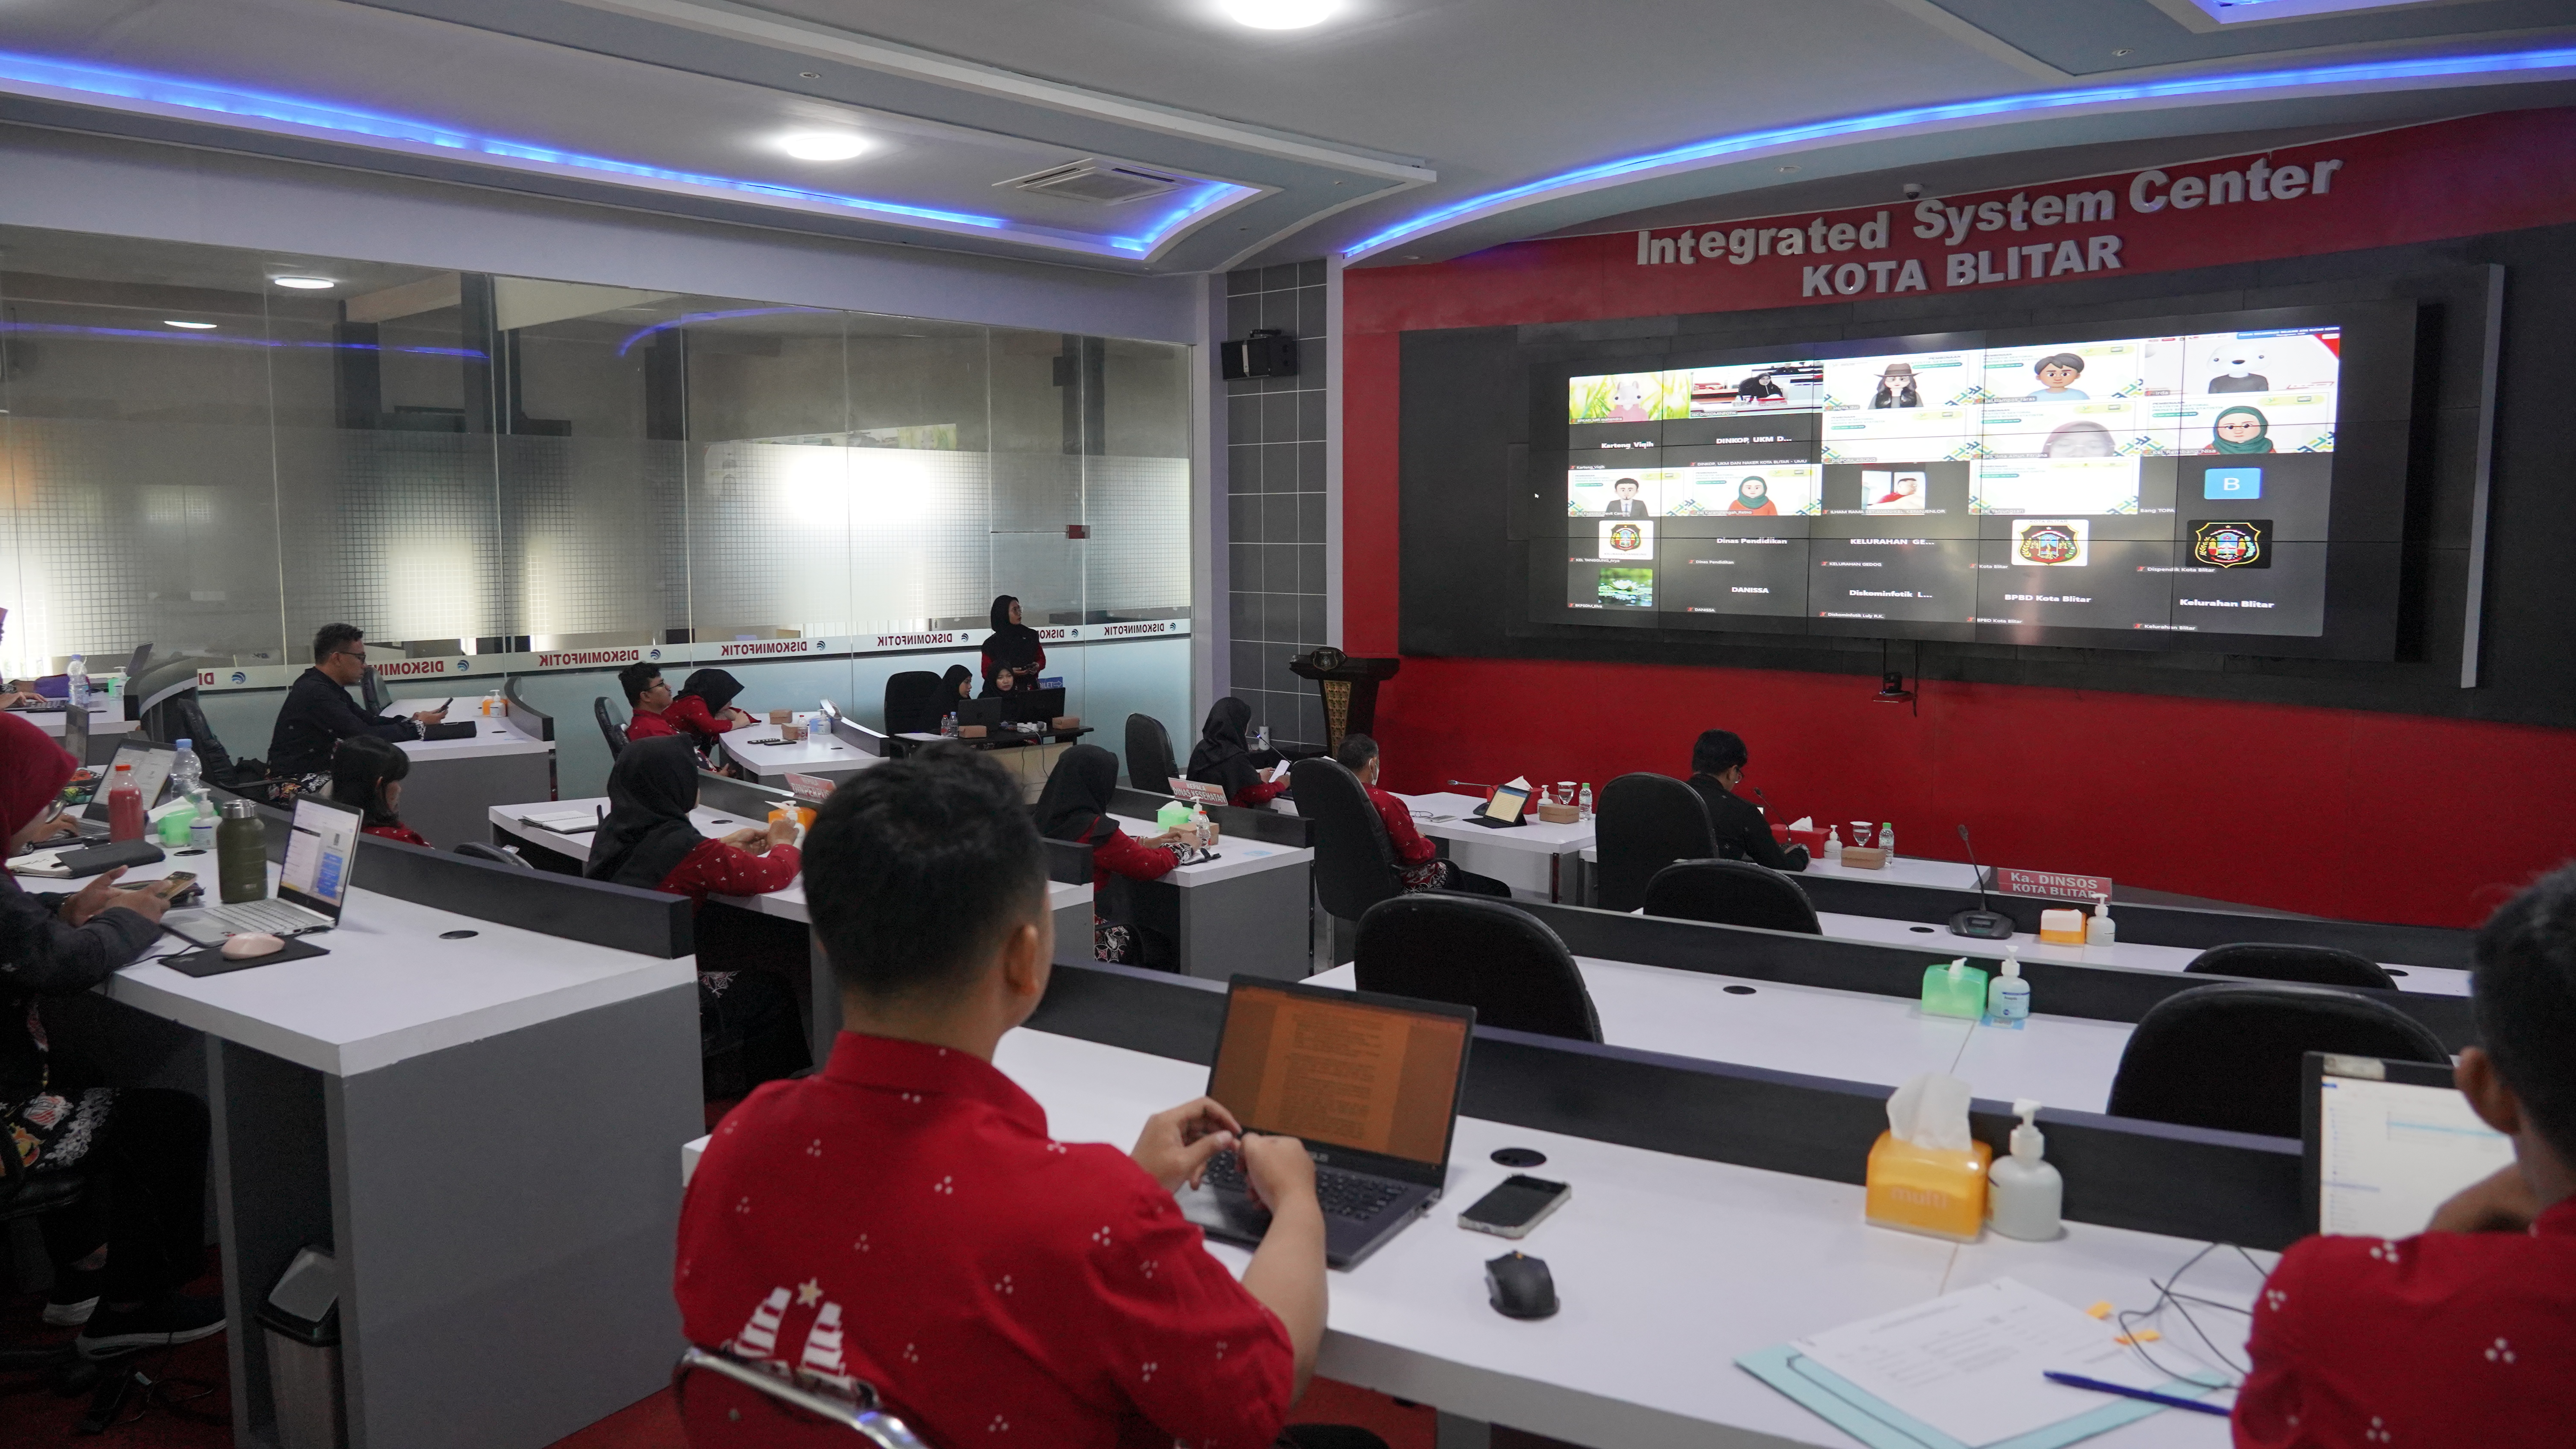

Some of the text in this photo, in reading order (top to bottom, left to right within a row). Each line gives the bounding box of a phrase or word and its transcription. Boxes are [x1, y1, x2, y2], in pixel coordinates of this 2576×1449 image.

[1637, 157, 2343, 265] Integrated System Center
[1802, 235, 2123, 297] KOTA BLITAR
[2224, 477, 2240, 491] B
[2180, 599, 2238, 607] Kelurahan
[1172, 787, 1227, 803] DINAS KESEHATAN
[1186, 783, 1206, 791] KEPALA
[2011, 872, 2098, 889] Ka. DINSOS
[2012, 883, 2096, 899] KOTA BLITAR
